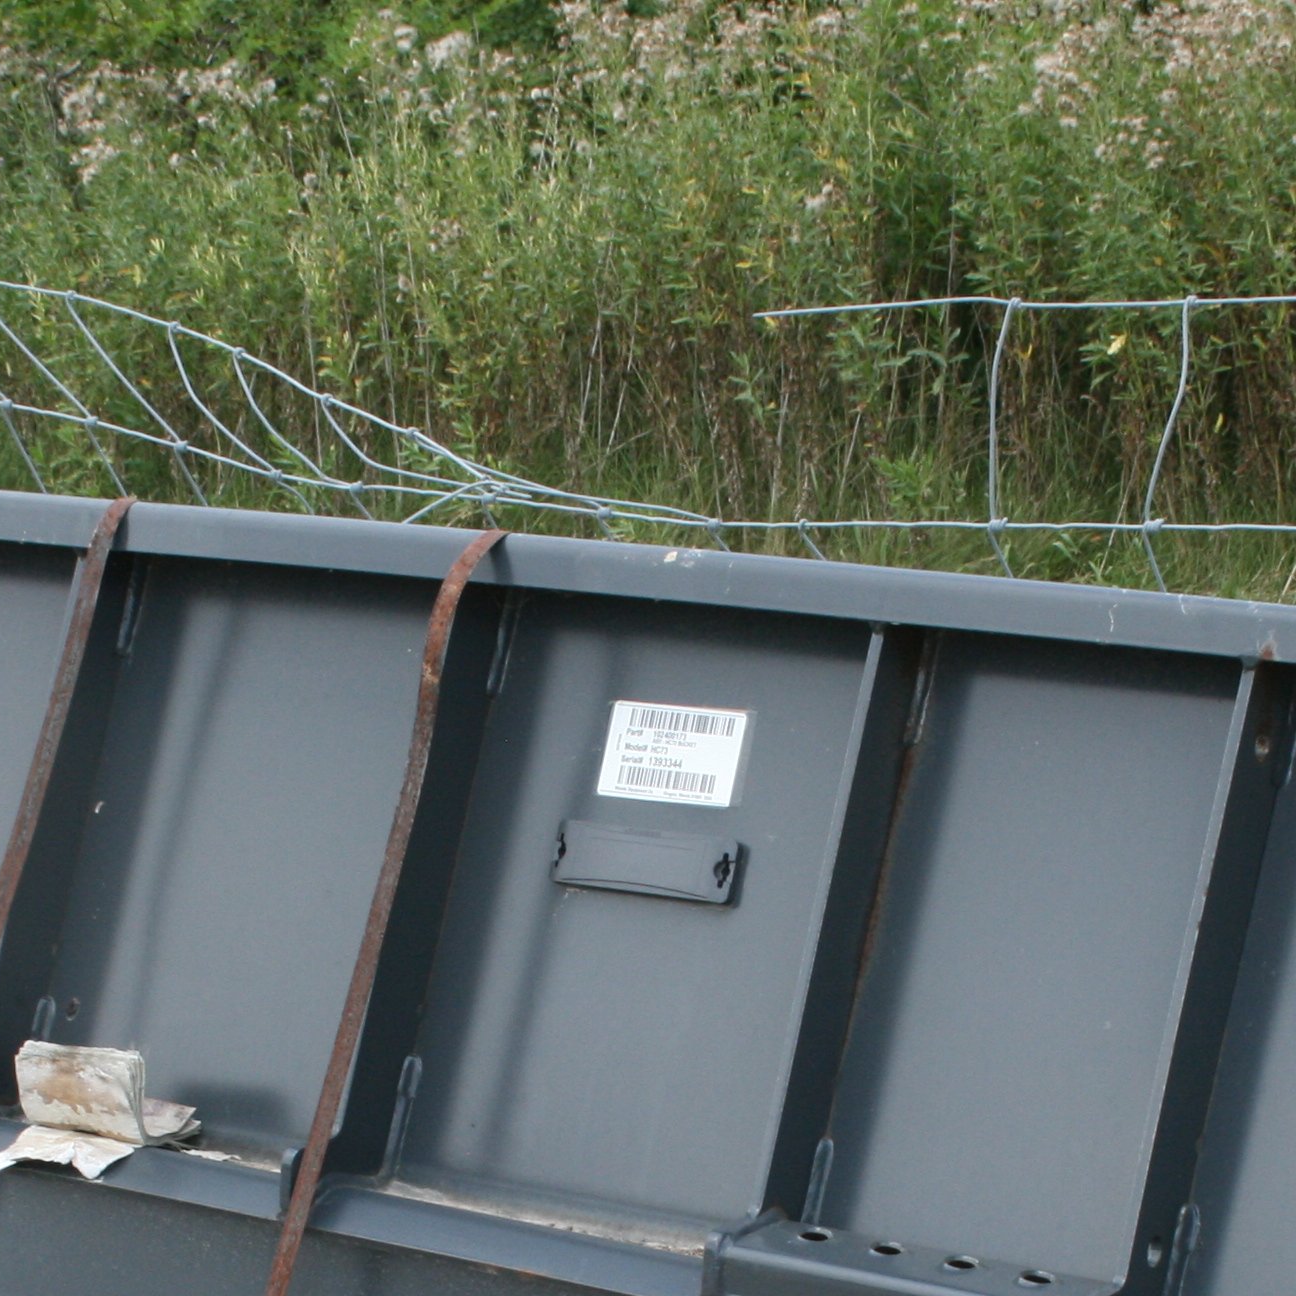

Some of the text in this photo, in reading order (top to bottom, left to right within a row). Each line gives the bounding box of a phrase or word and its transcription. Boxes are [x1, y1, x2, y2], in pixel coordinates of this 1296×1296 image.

[626, 727, 644, 737] Part#
[624, 742, 648, 753] Model#
[650, 745, 669, 755] HC73
[621, 755, 683, 769] Serial# 1393344
